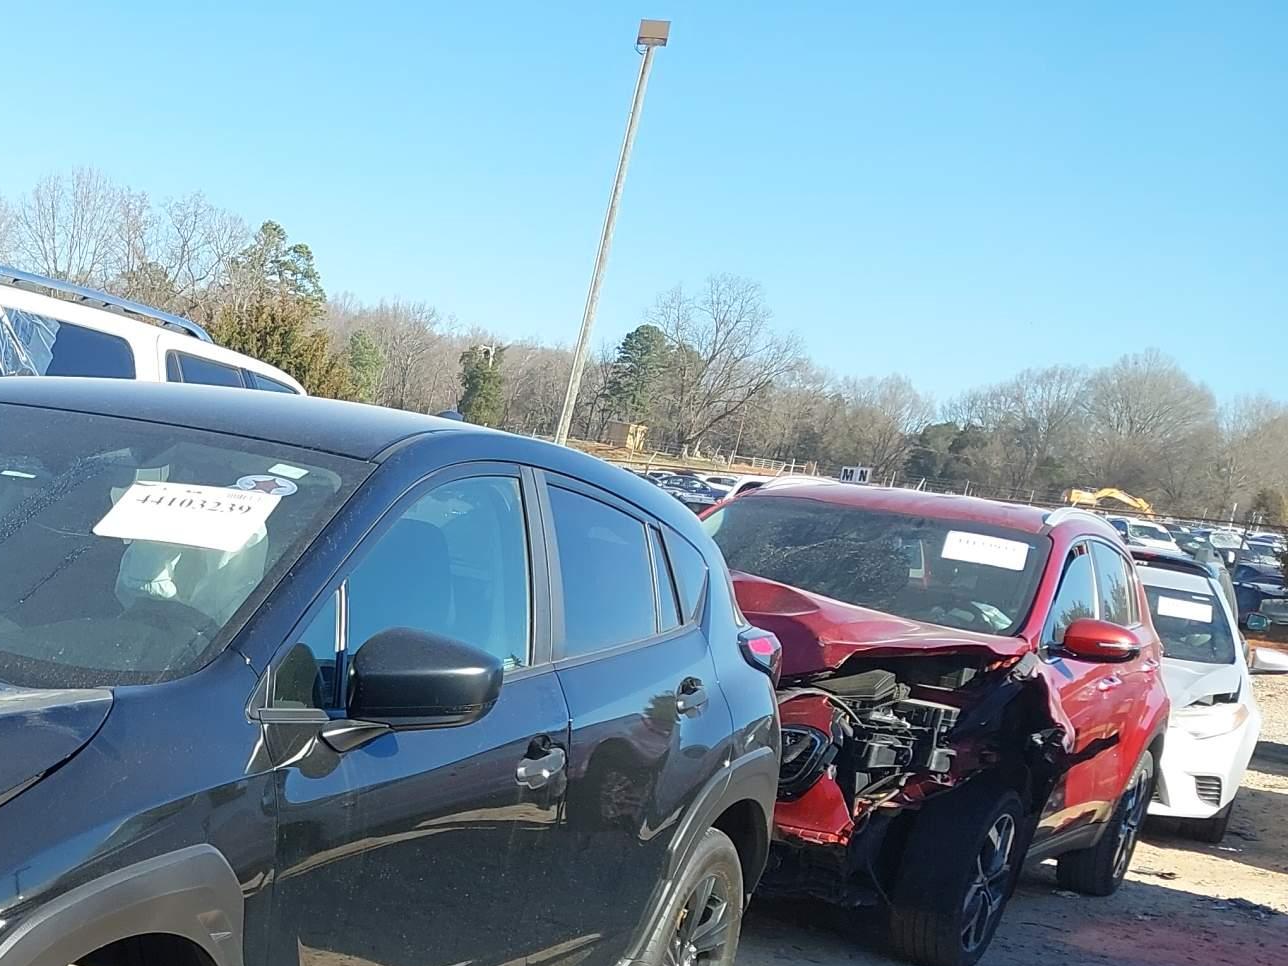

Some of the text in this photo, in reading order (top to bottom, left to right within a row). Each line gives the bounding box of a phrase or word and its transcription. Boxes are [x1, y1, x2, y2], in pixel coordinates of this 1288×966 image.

[842, 468, 868, 482] M N
[136, 494, 253, 514] 44103239
